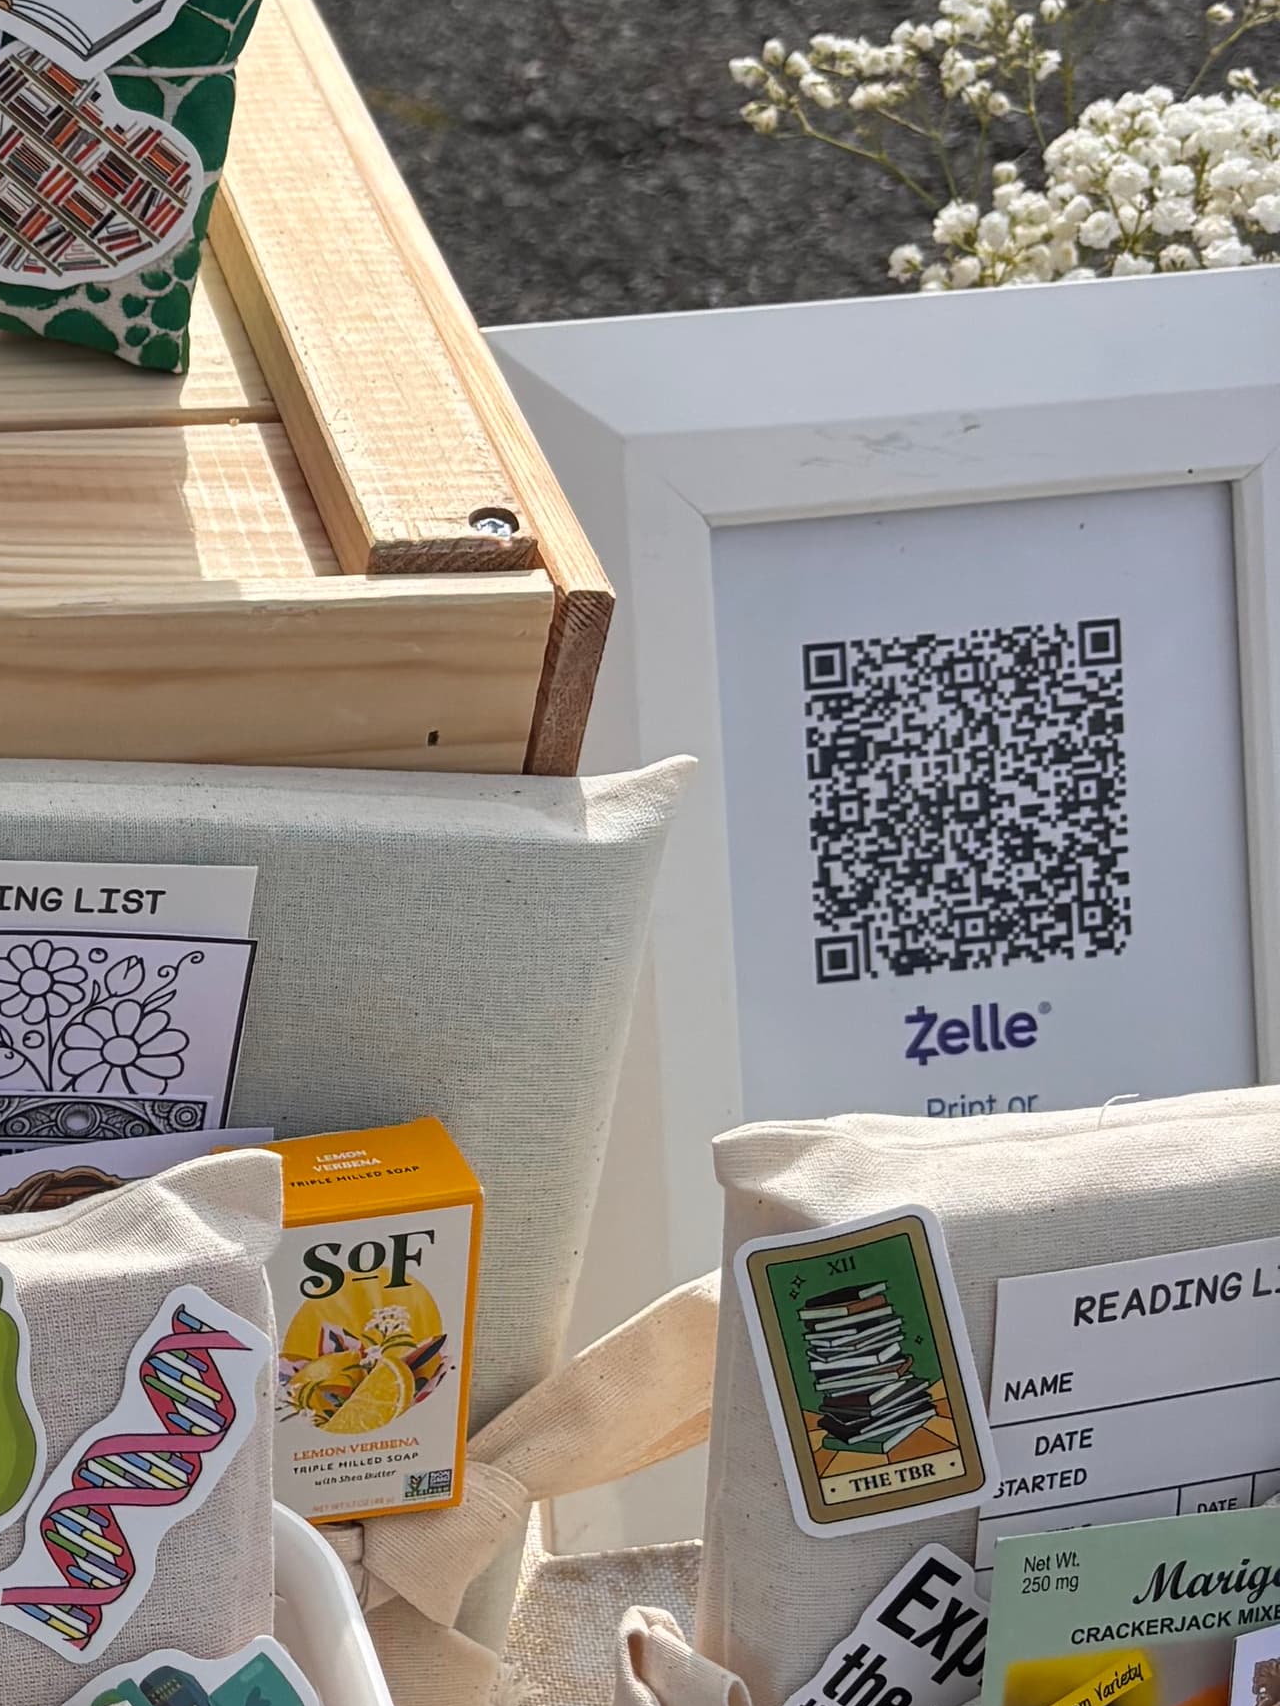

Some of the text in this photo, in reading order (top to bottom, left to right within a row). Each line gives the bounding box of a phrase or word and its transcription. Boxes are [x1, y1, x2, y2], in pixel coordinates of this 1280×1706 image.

[74, 888, 166, 915] LIST
[312, 1157, 382, 1172] VERBENA
[316, 1150, 367, 1163] LEMON
[290, 1166, 420, 1188] TRIPLE MILLED SOAP
[1073, 1272, 1243, 1327] READING
[1003, 1372, 1074, 1402] NAME
[293, 1437, 419, 1461] LEMON VERBENA
[1034, 1428, 1094, 1457] DATE
[293, 1452, 419, 1475] TRIPLE MILLED SOAP
[849, 1462, 937, 1494] THE TBR
[993, 1466, 1088, 1500] STARTED
[1196, 1497, 1239, 1514] DATE
[1023, 1550, 1081, 1574] Net Wt.
[1021, 1574, 1080, 1594] 250 mg
[1069, 1609, 1232, 1647] CRACKERJACK
[1094, 1661, 1145, 1702] Variety
